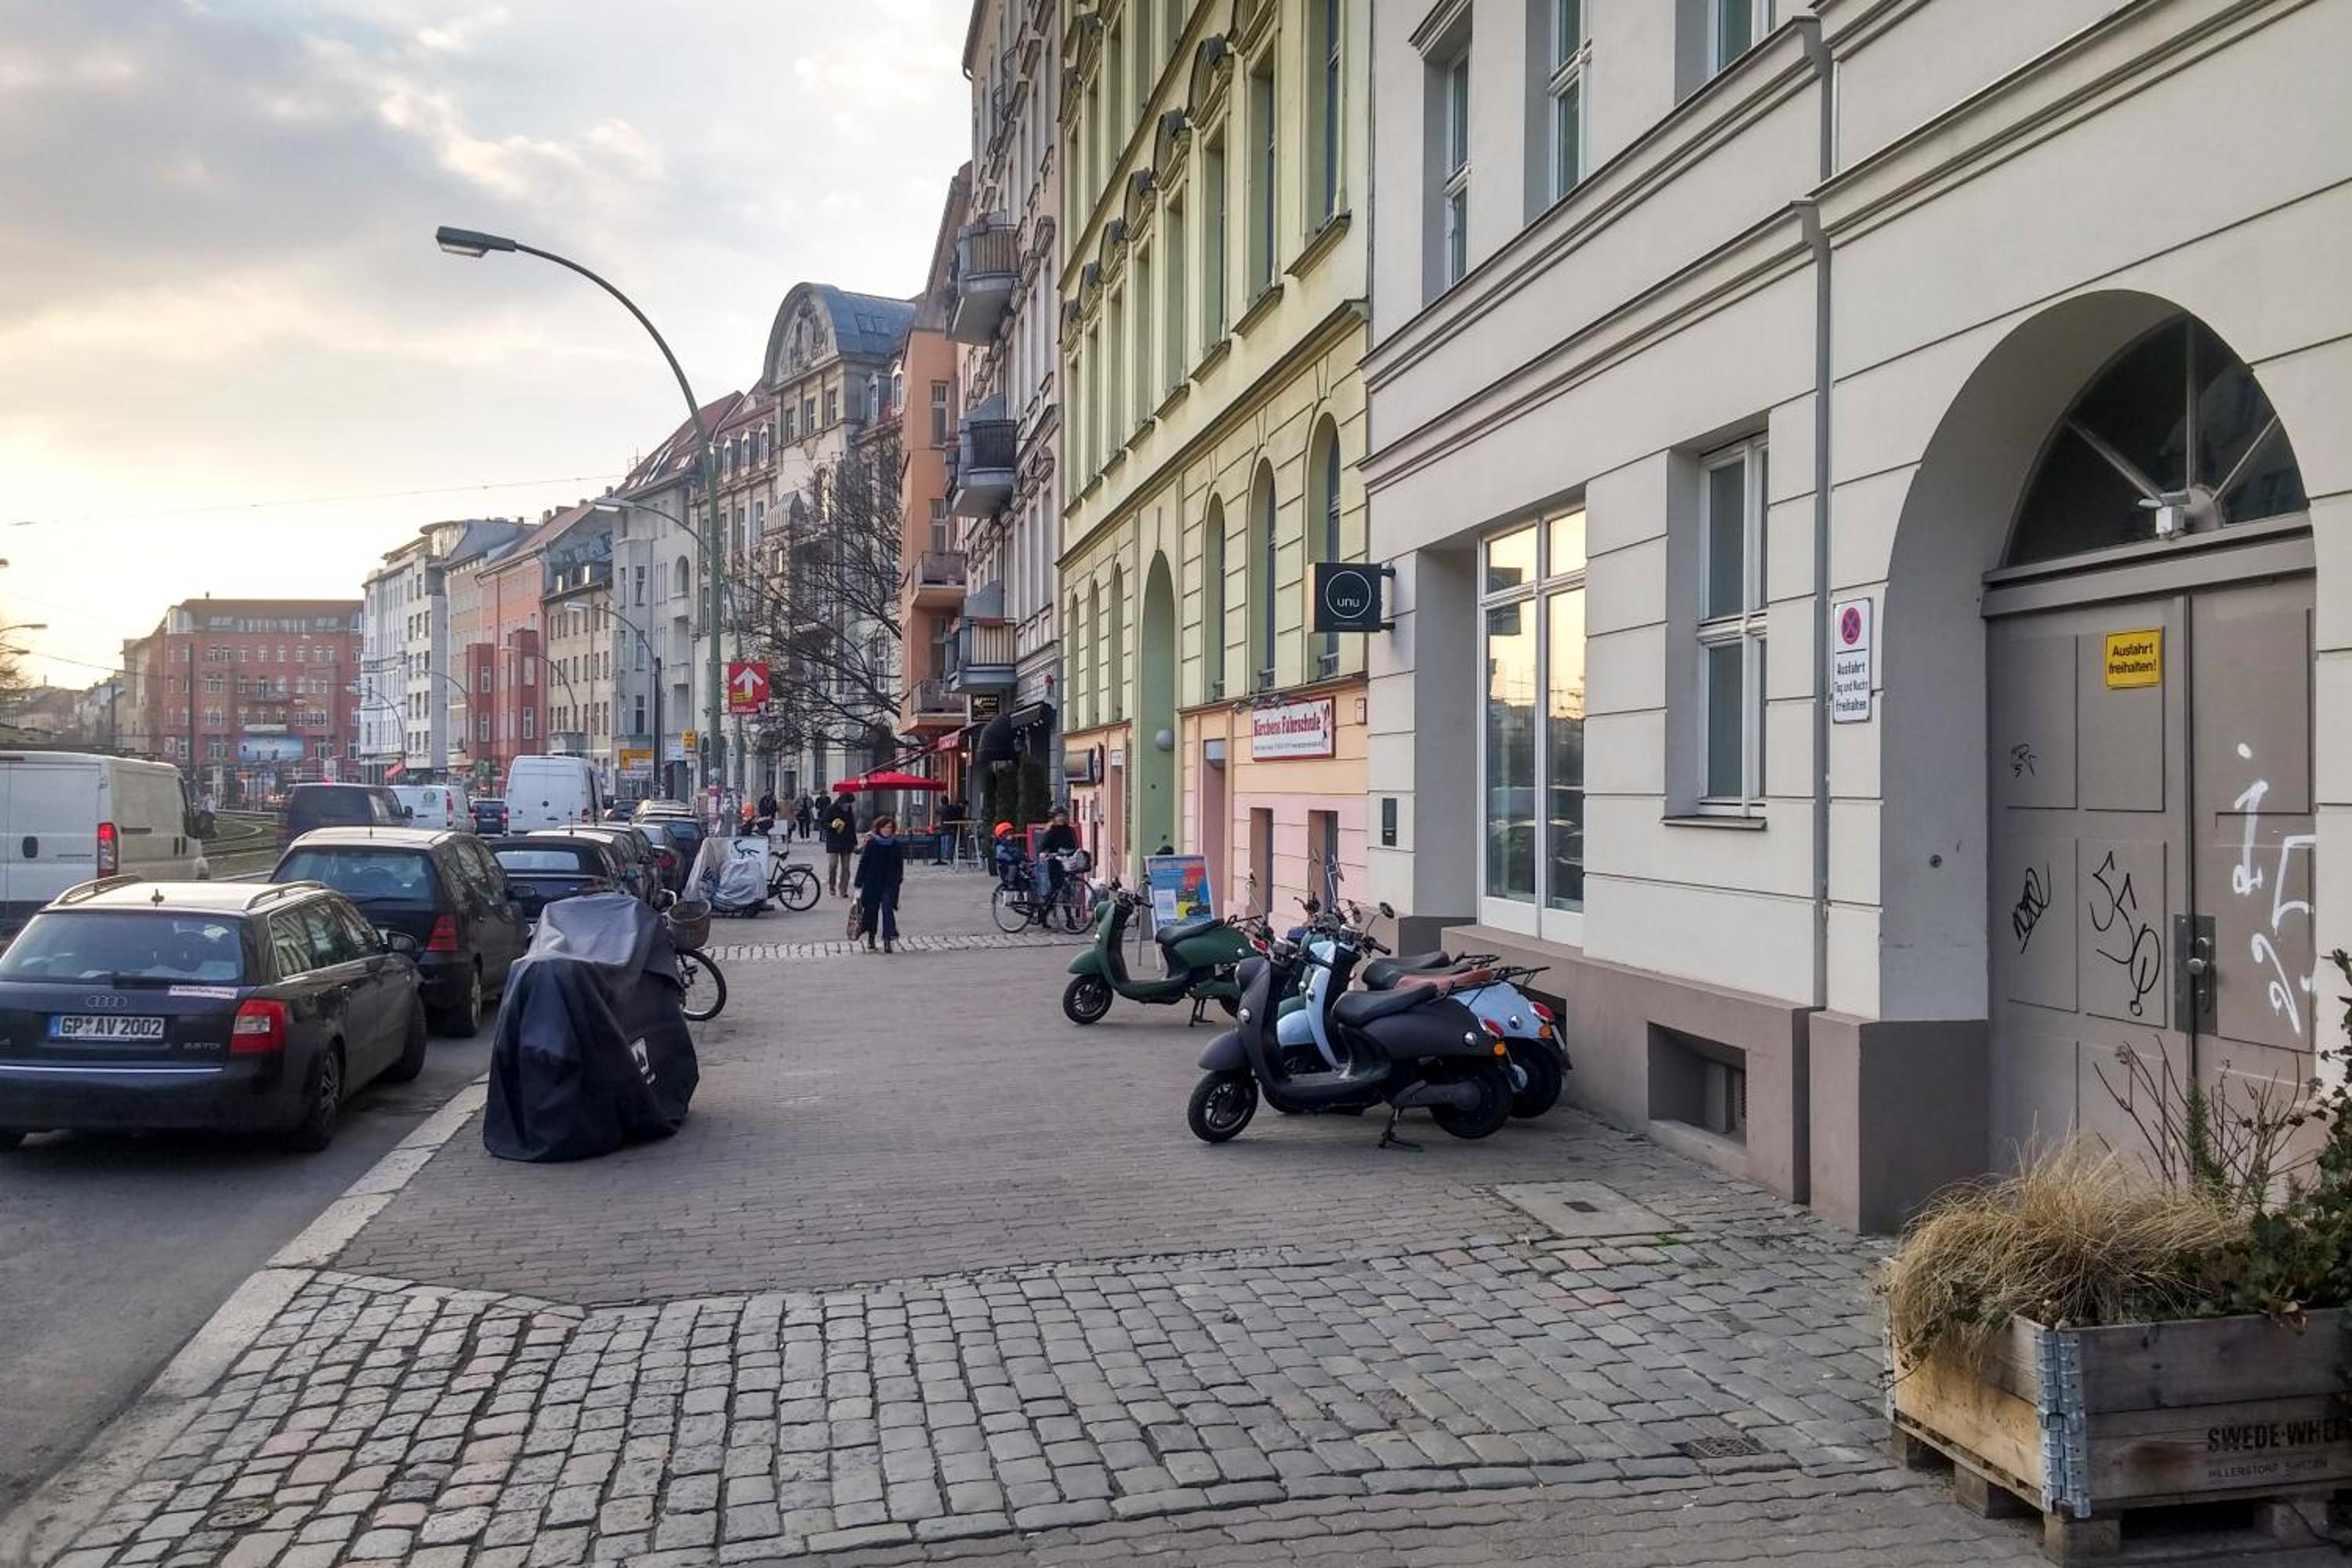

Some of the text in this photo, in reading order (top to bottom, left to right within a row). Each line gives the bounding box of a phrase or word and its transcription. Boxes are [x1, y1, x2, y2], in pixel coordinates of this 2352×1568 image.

[1337, 597, 1360, 608] unu
[2113, 643, 2154, 657] Ausfahrt
[1837, 661, 1865, 674] Ausfahrt
[2108, 659, 2157, 675] freihalten!
[1843, 681, 1853, 691] und
[1853, 680, 1868, 691] Nacht
[1835, 698, 1867, 712] freihalten
[1282, 713, 1320, 735] Fahrschule
[62, 1017, 163, 1036] GP AV 2002
